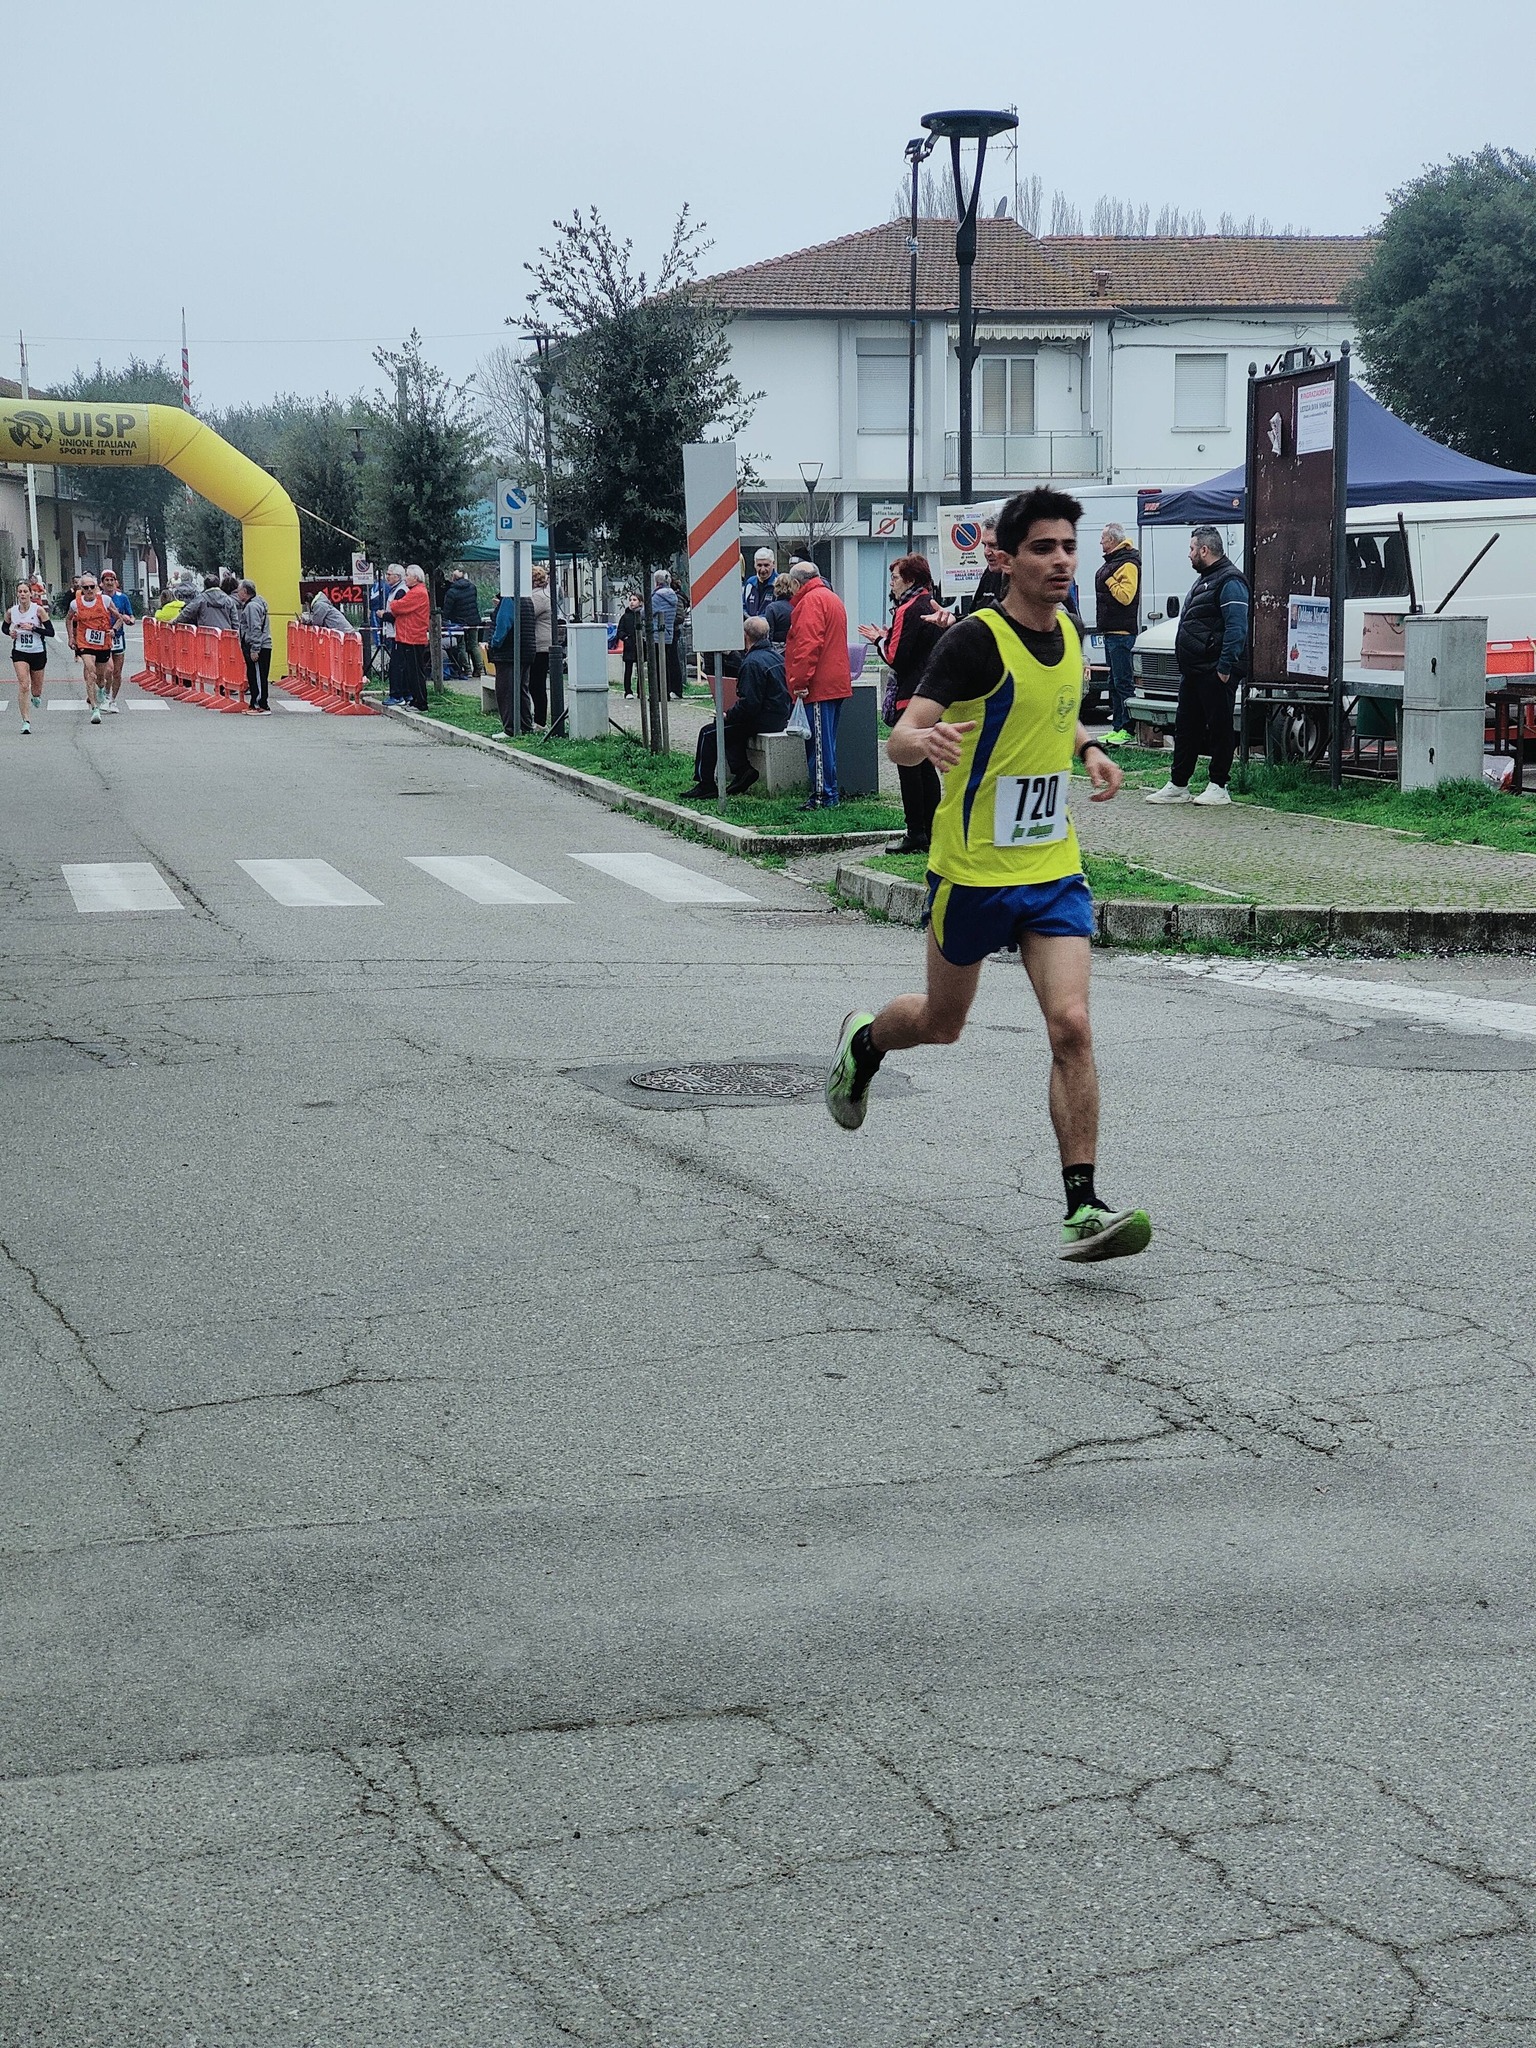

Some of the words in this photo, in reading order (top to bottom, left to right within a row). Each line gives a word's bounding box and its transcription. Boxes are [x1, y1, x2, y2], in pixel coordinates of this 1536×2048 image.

[58, 411, 136, 438] UISP
[59, 438, 94, 448] UNIONE
[97, 440, 137, 449] ITALIANA
[59, 447, 87, 456] SPORT
[90, 448, 106, 456] PER
[502, 517, 511, 528] P
[20, 634, 33, 644] 663
[90, 629, 102, 641] 651
[1014, 775, 1059, 821] 720
